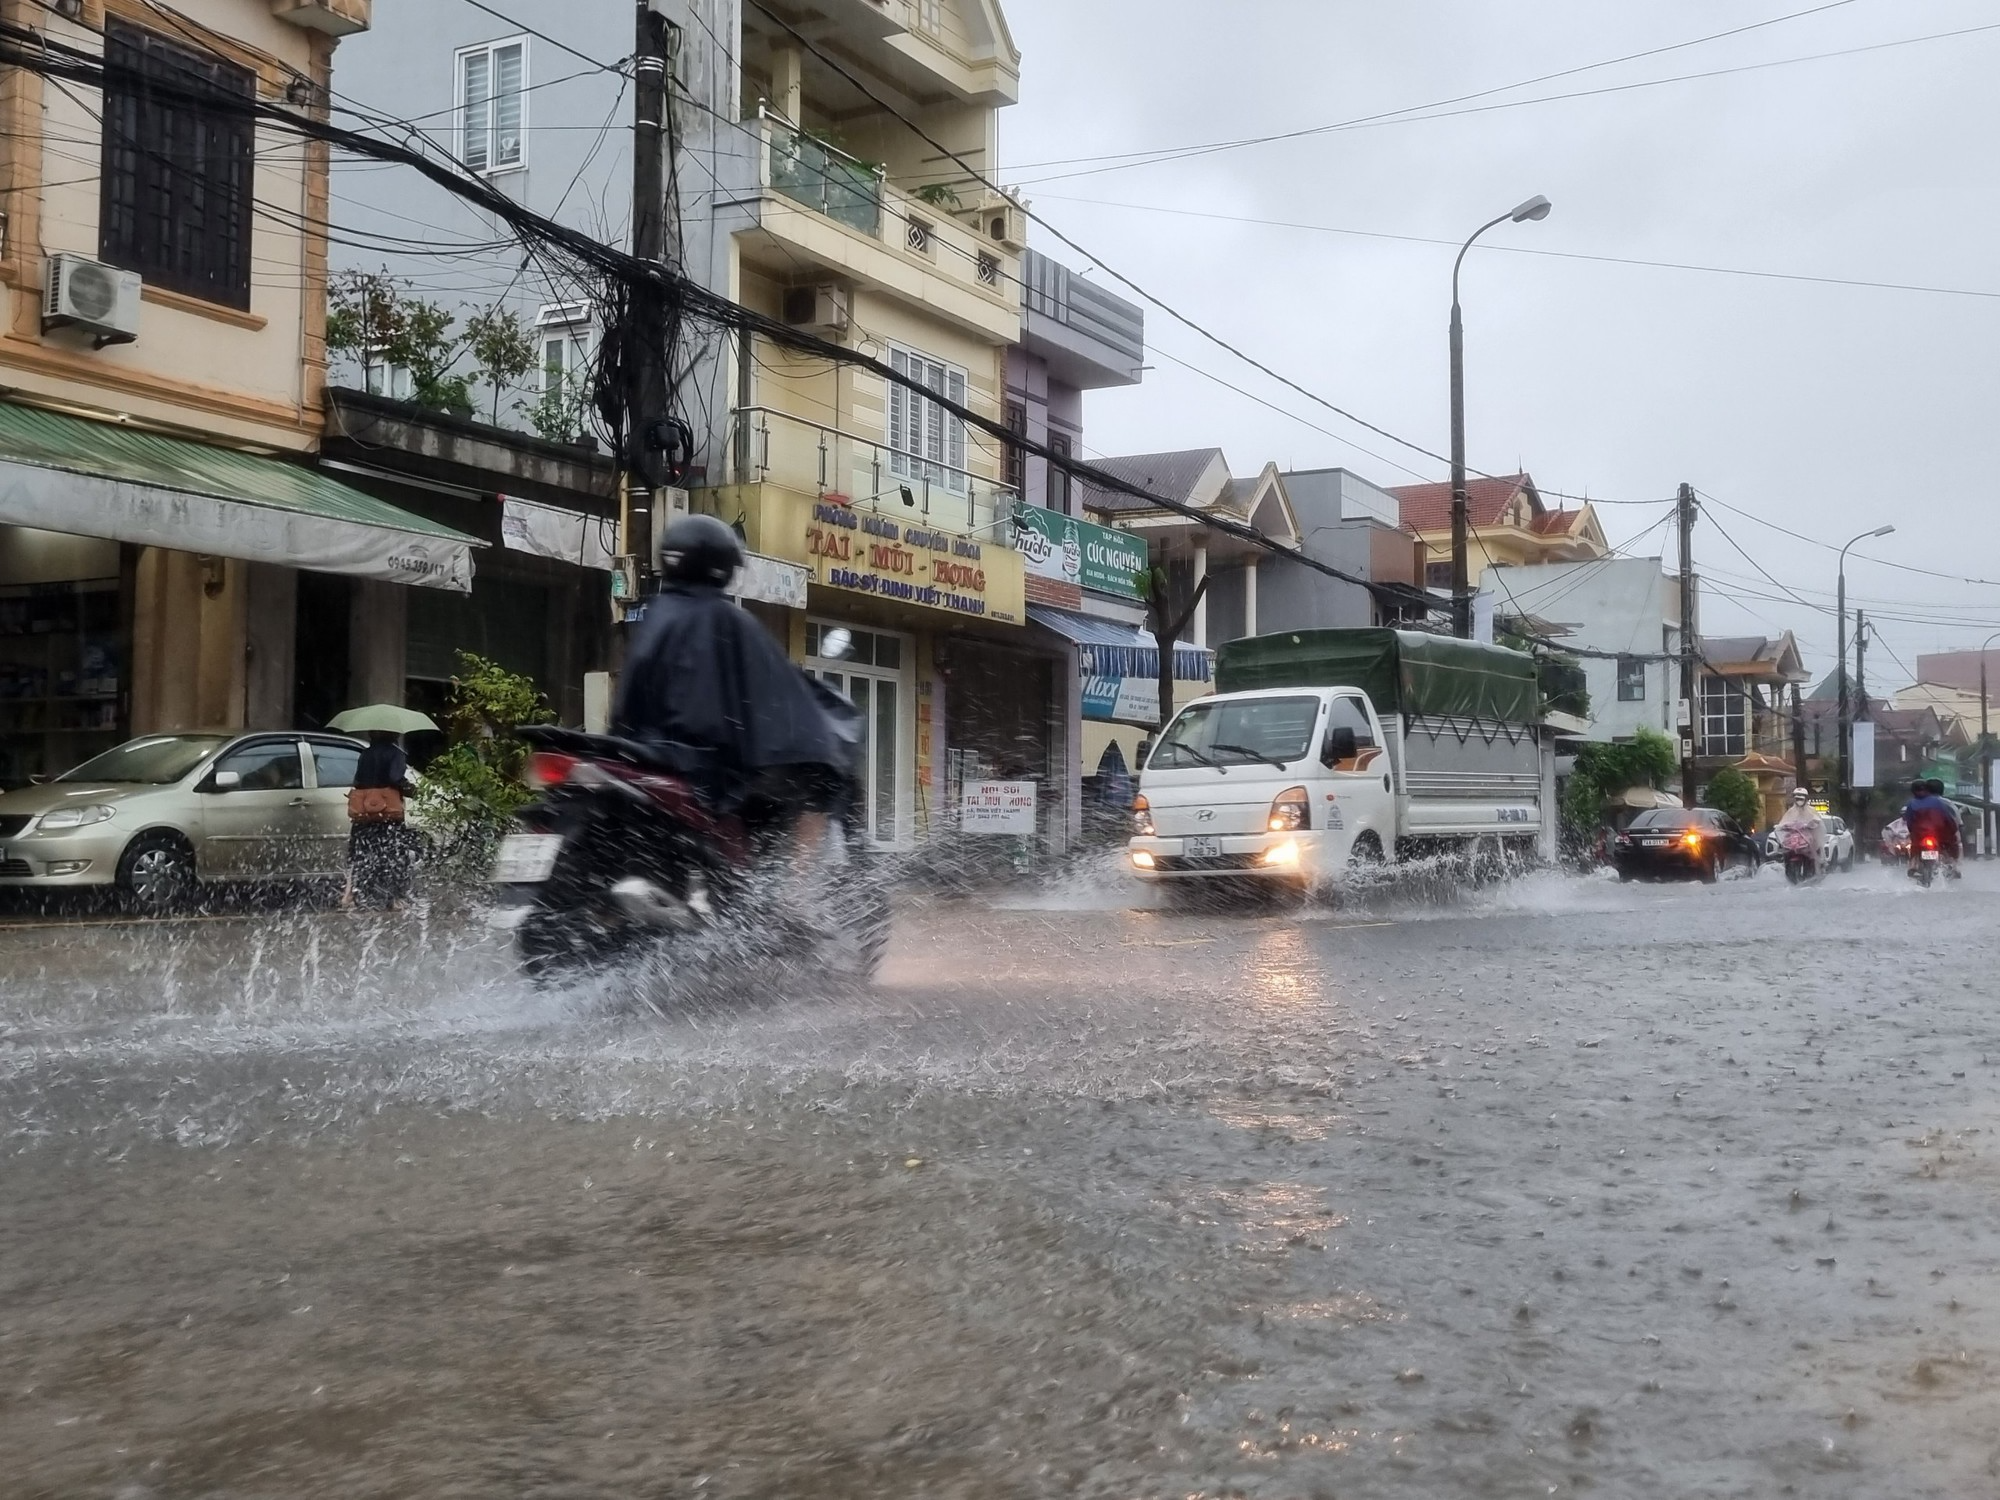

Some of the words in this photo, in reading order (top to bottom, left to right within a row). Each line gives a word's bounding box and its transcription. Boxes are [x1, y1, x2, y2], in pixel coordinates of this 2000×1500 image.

[806, 527, 850, 560] TAI
[932, 559, 986, 592] HỌNG
[1086, 541, 1105, 566] CÚC
[1106, 546, 1142, 573] NGUYÊN
[942, 591, 985, 615] THANH
[1085, 676, 1119, 698] Kixx
[966, 796, 980, 806] TAI
